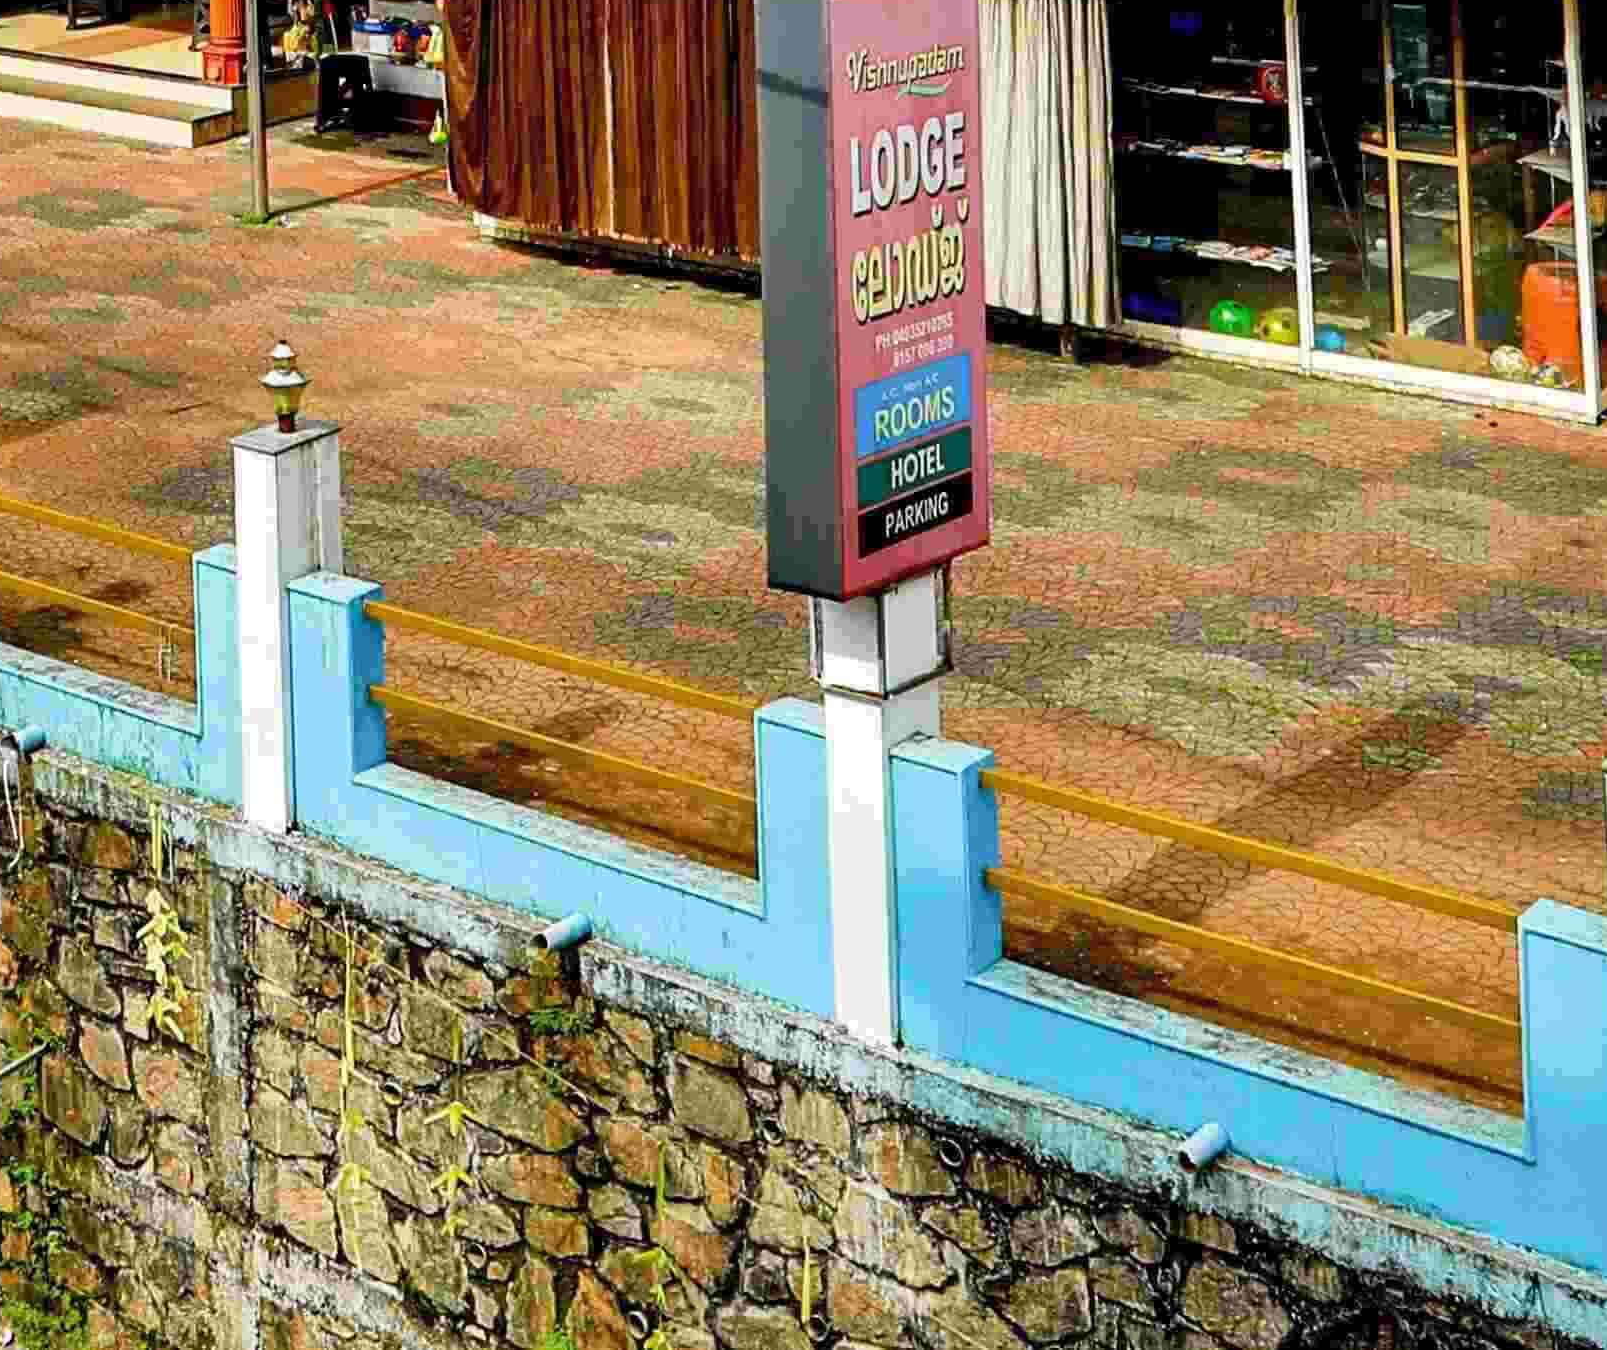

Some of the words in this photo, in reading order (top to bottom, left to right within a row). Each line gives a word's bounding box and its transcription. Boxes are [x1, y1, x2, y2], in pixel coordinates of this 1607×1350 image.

[847, 43, 963, 93] Vishnupadam
[849, 111, 967, 218] LODGE
[874, 385, 955, 443] ROOMS
[891, 443, 945, 490] HOTEL
[884, 491, 949, 538] PARKING
